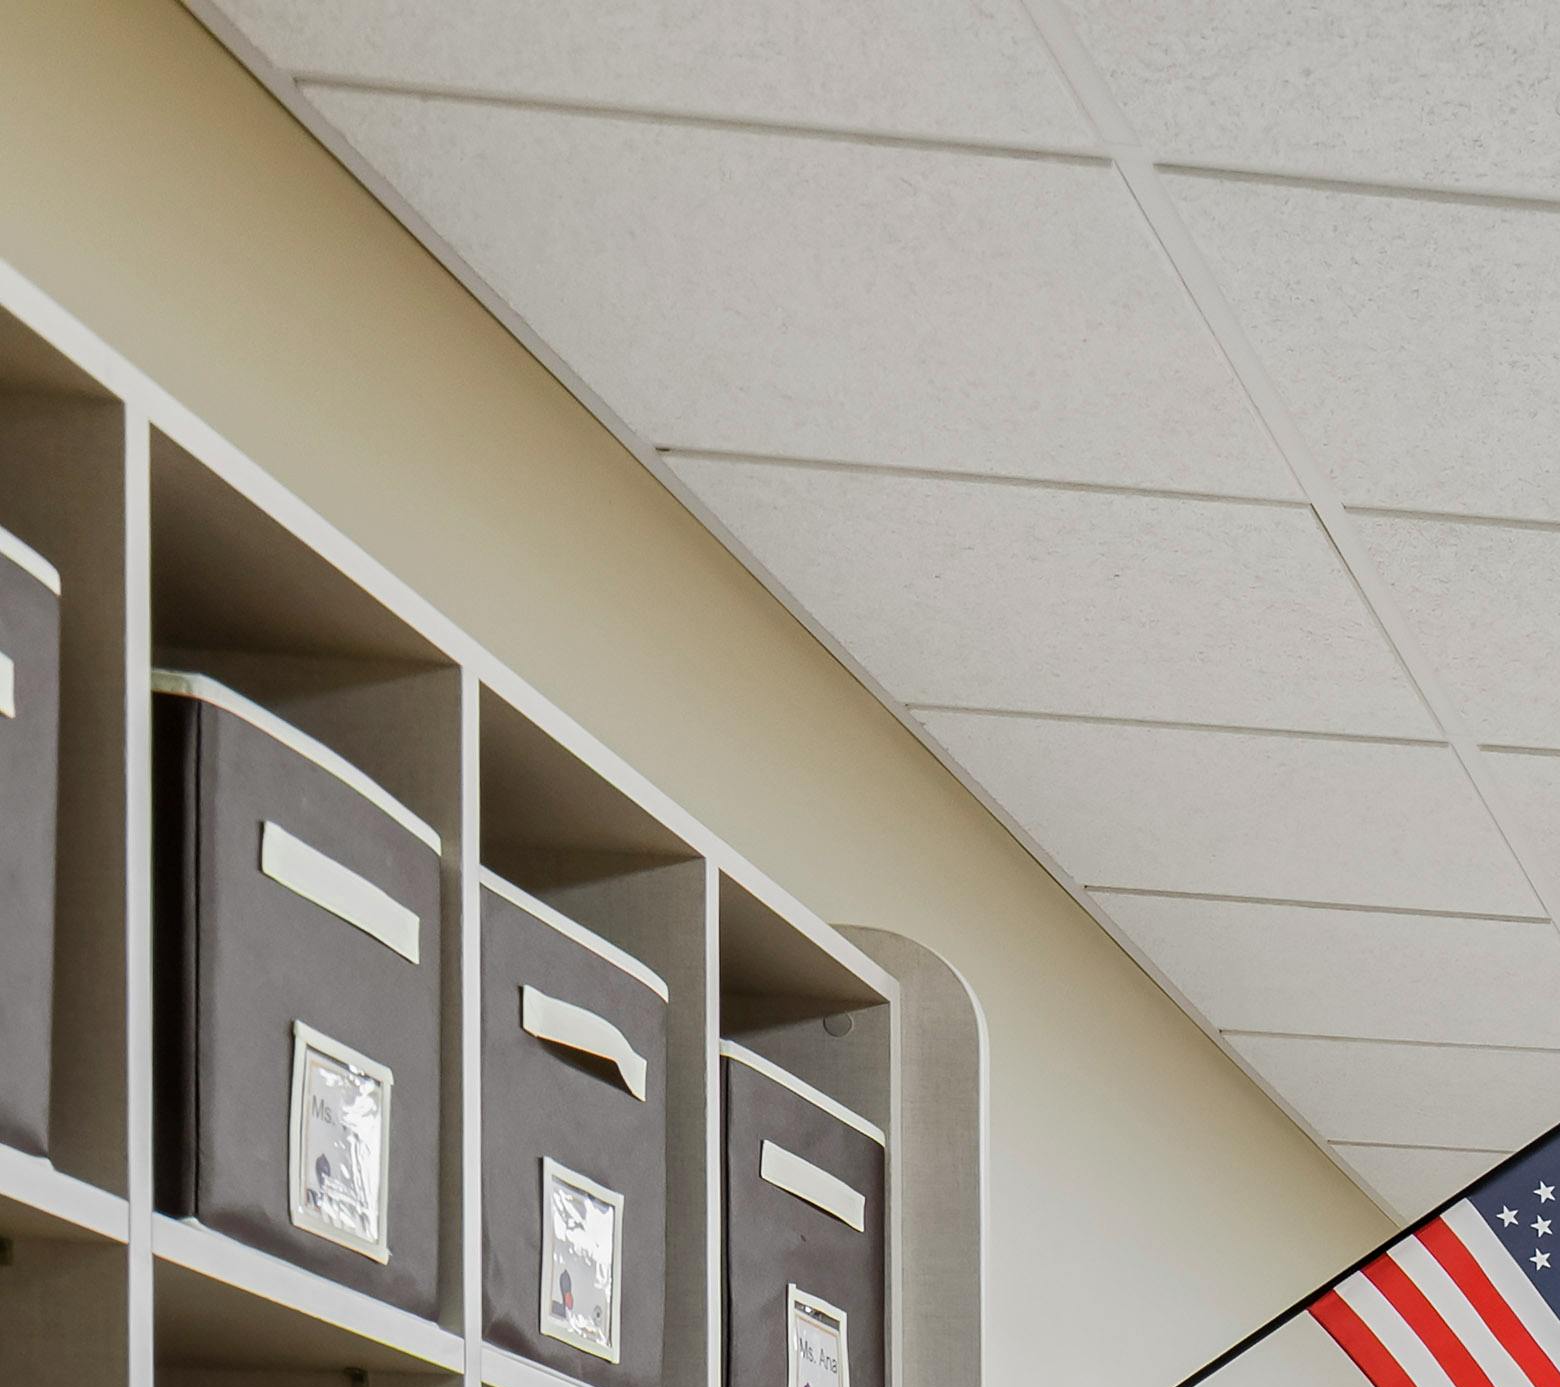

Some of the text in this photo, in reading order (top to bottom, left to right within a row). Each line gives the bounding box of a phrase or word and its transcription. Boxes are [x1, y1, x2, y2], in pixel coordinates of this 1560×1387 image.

[312, 1094, 336, 1126] Ms.
[799, 1336, 838, 1374] Ms. Ana
